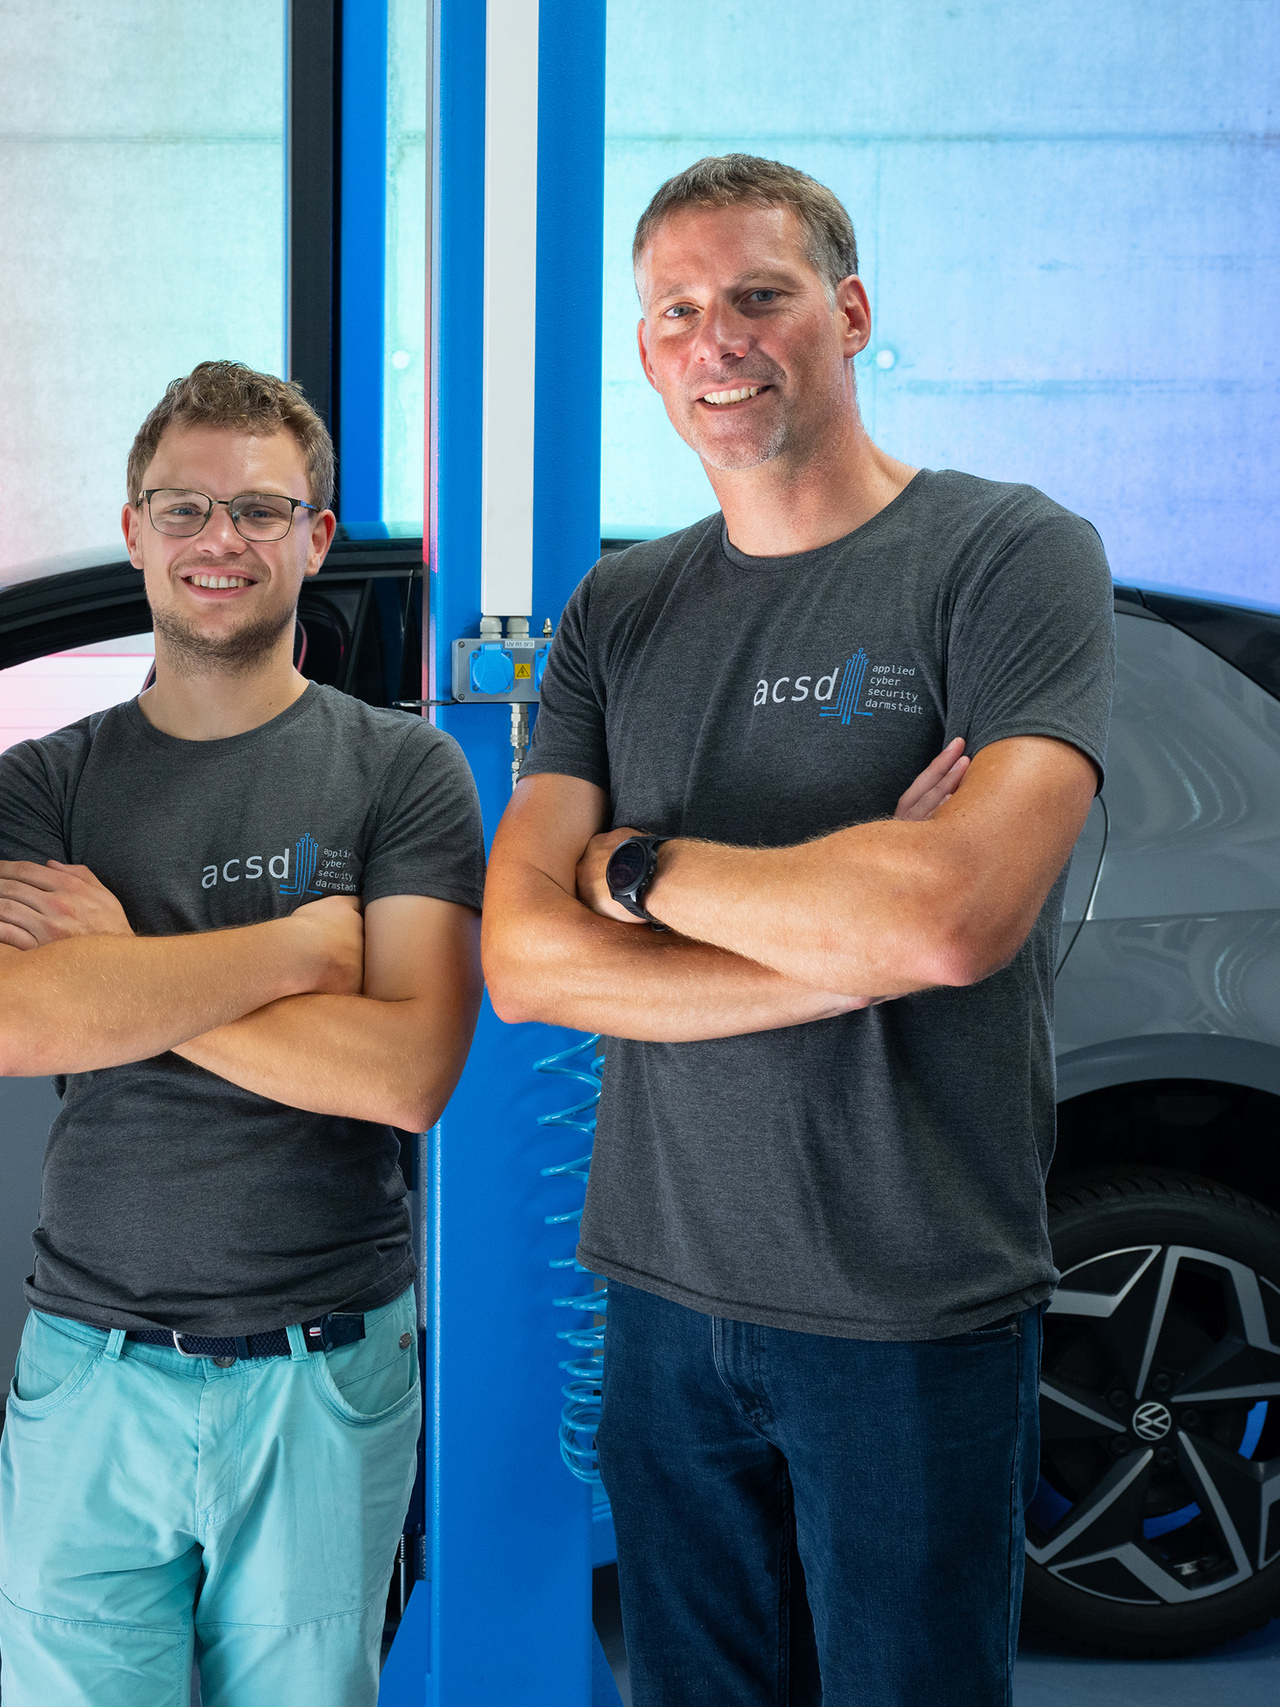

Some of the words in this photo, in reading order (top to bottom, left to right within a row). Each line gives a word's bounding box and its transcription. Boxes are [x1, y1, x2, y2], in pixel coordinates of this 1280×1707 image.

[872, 664, 916, 676] applied
[753, 667, 840, 706] acsd
[870, 676, 901, 687] cyber
[867, 687, 919, 702] security
[865, 699, 923, 715] darmstadt
[323, 848, 352, 859] appli
[201, 848, 290, 889] acsd
[321, 858, 347, 869] cyber
[315, 879, 357, 892] darmstadt
